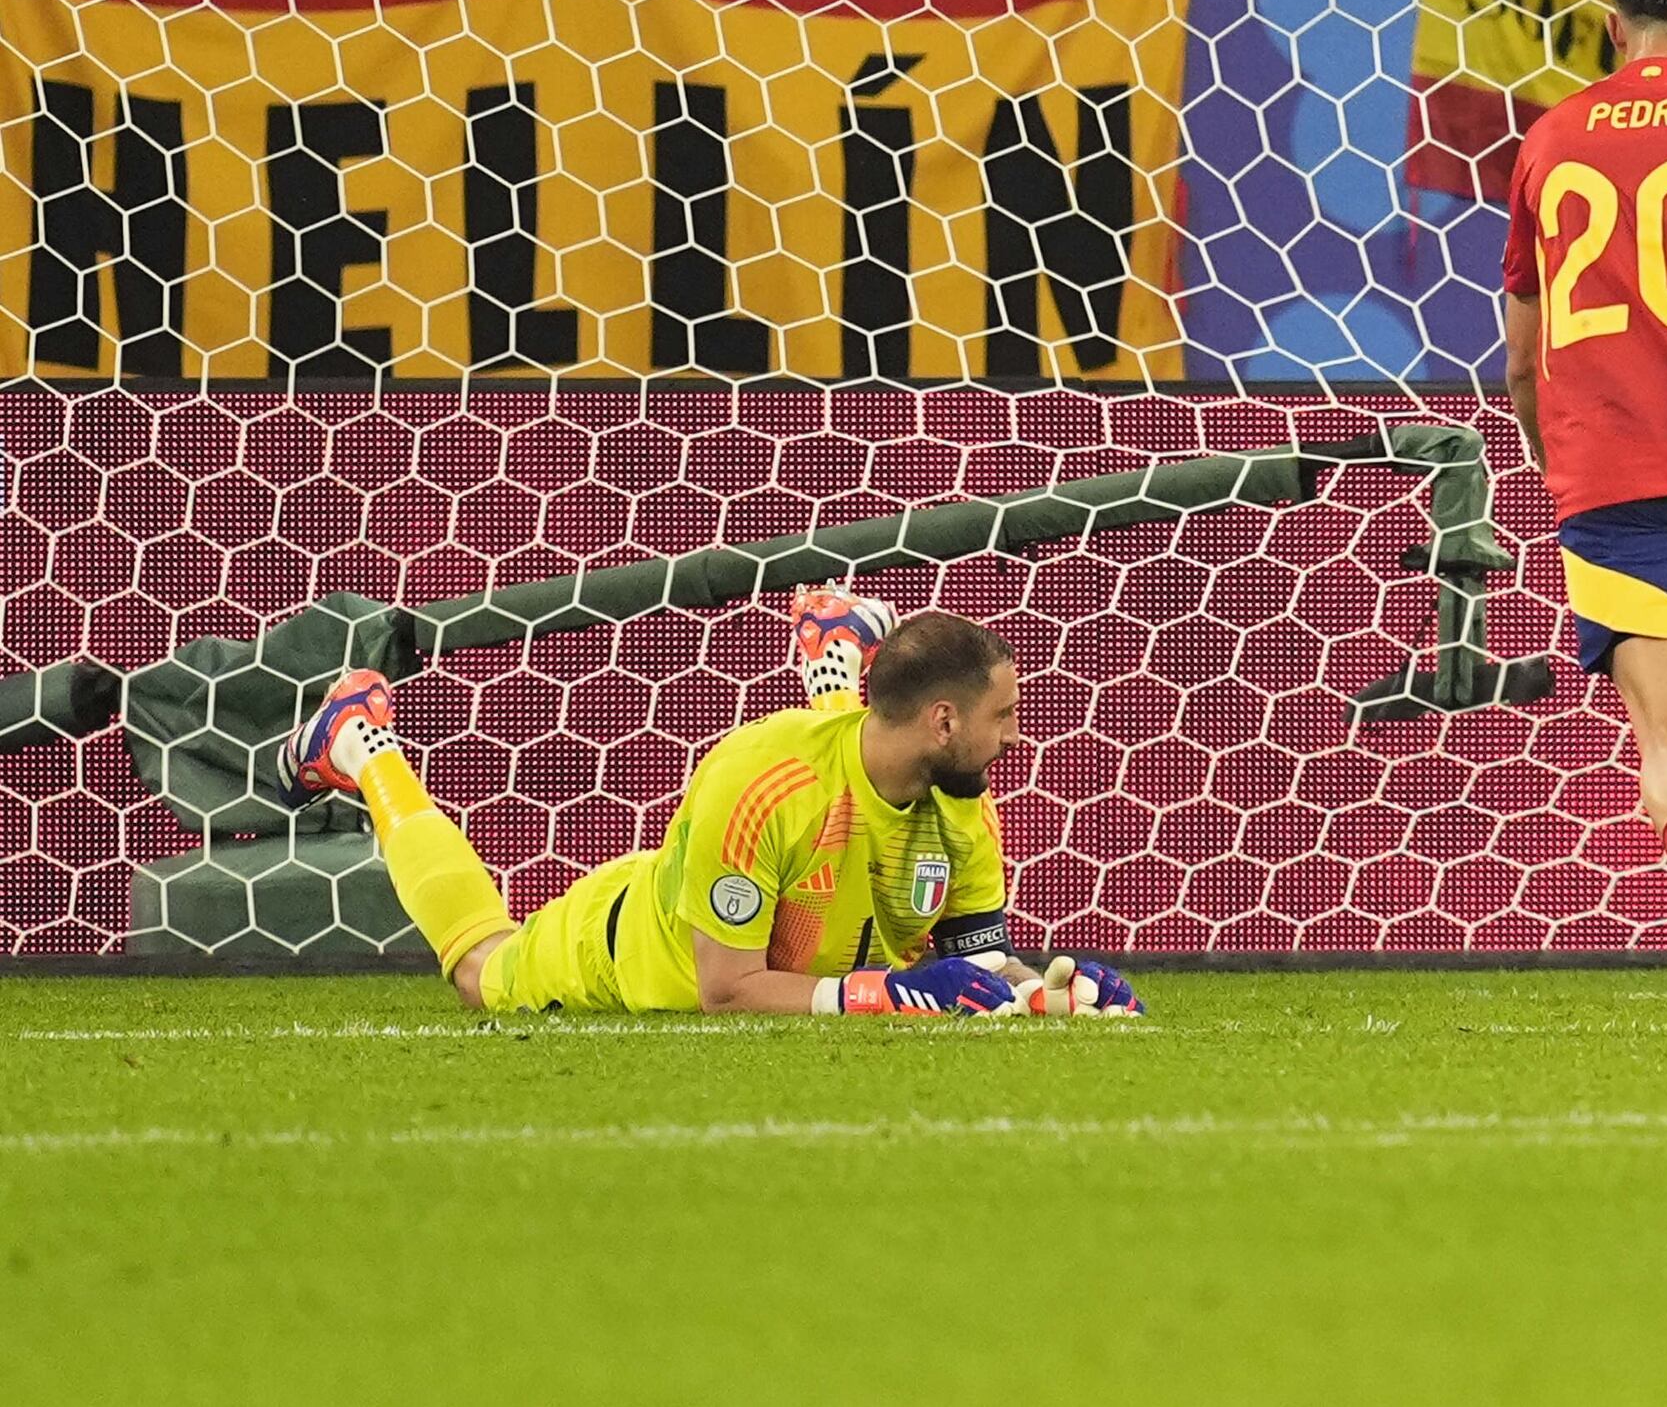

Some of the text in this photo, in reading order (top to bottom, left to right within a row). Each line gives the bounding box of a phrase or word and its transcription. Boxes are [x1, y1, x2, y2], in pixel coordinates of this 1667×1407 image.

[28, 52, 1136, 378] HELLÍN
[916, 865, 946, 878] ITALIA
[955, 928, 1005, 951] RESPECT
